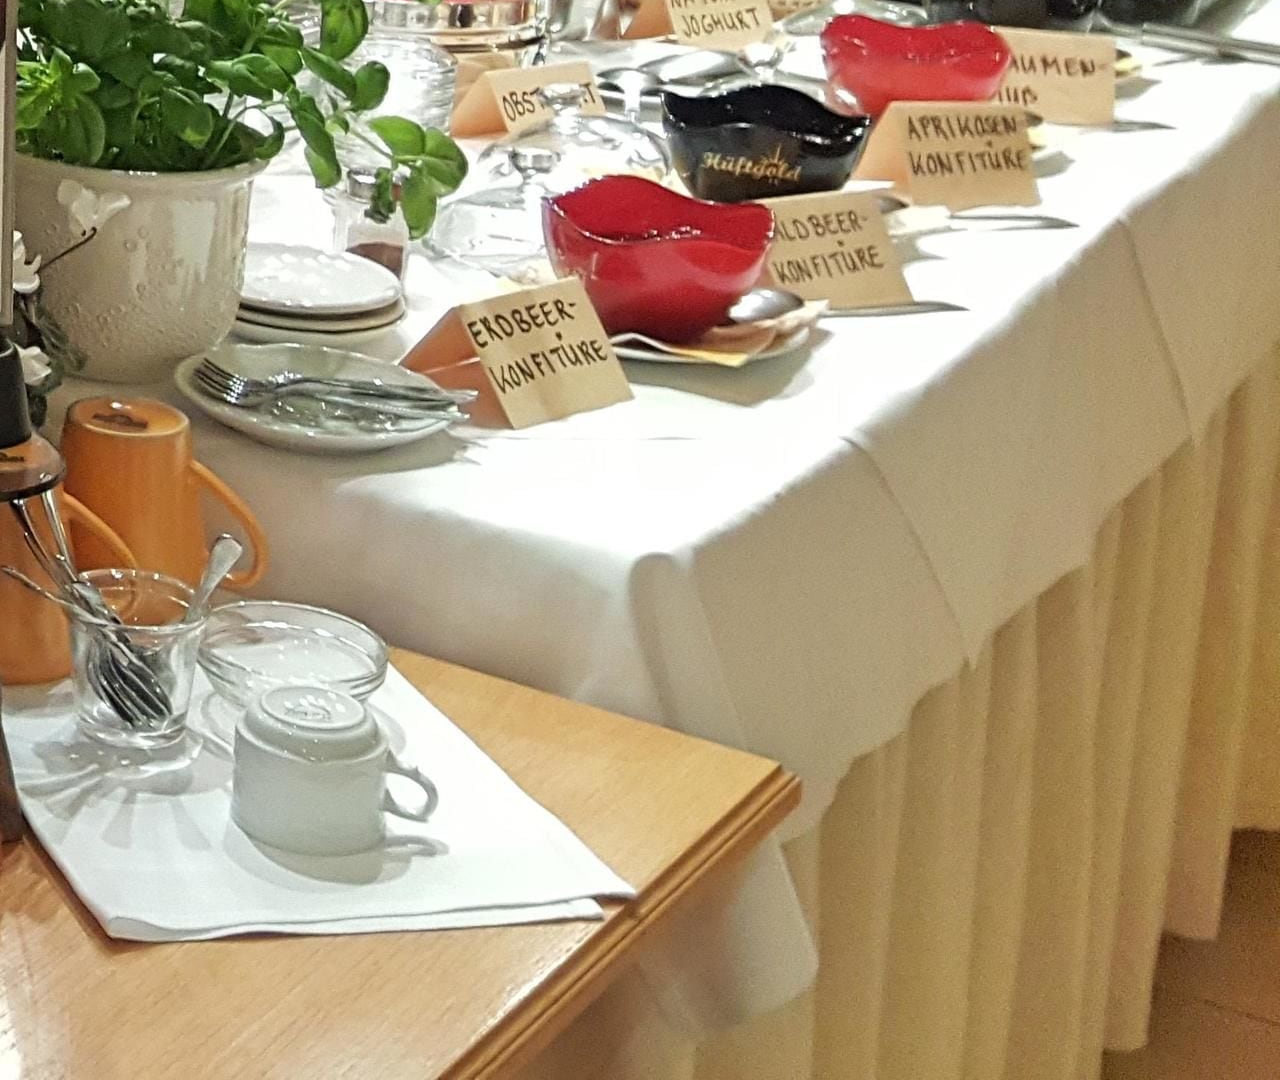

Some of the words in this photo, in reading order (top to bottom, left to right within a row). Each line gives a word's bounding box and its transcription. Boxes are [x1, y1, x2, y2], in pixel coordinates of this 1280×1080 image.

[682, 7, 761, 37] JOGHURT
[701, 150, 801, 182] Hüftgold
[908, 139, 1026, 177] KONFITÜRE
[772, 239, 885, 284] KONFITÜRE
[467, 298, 577, 349] ERDBEER-
[488, 331, 608, 394] KONFITÜRE
